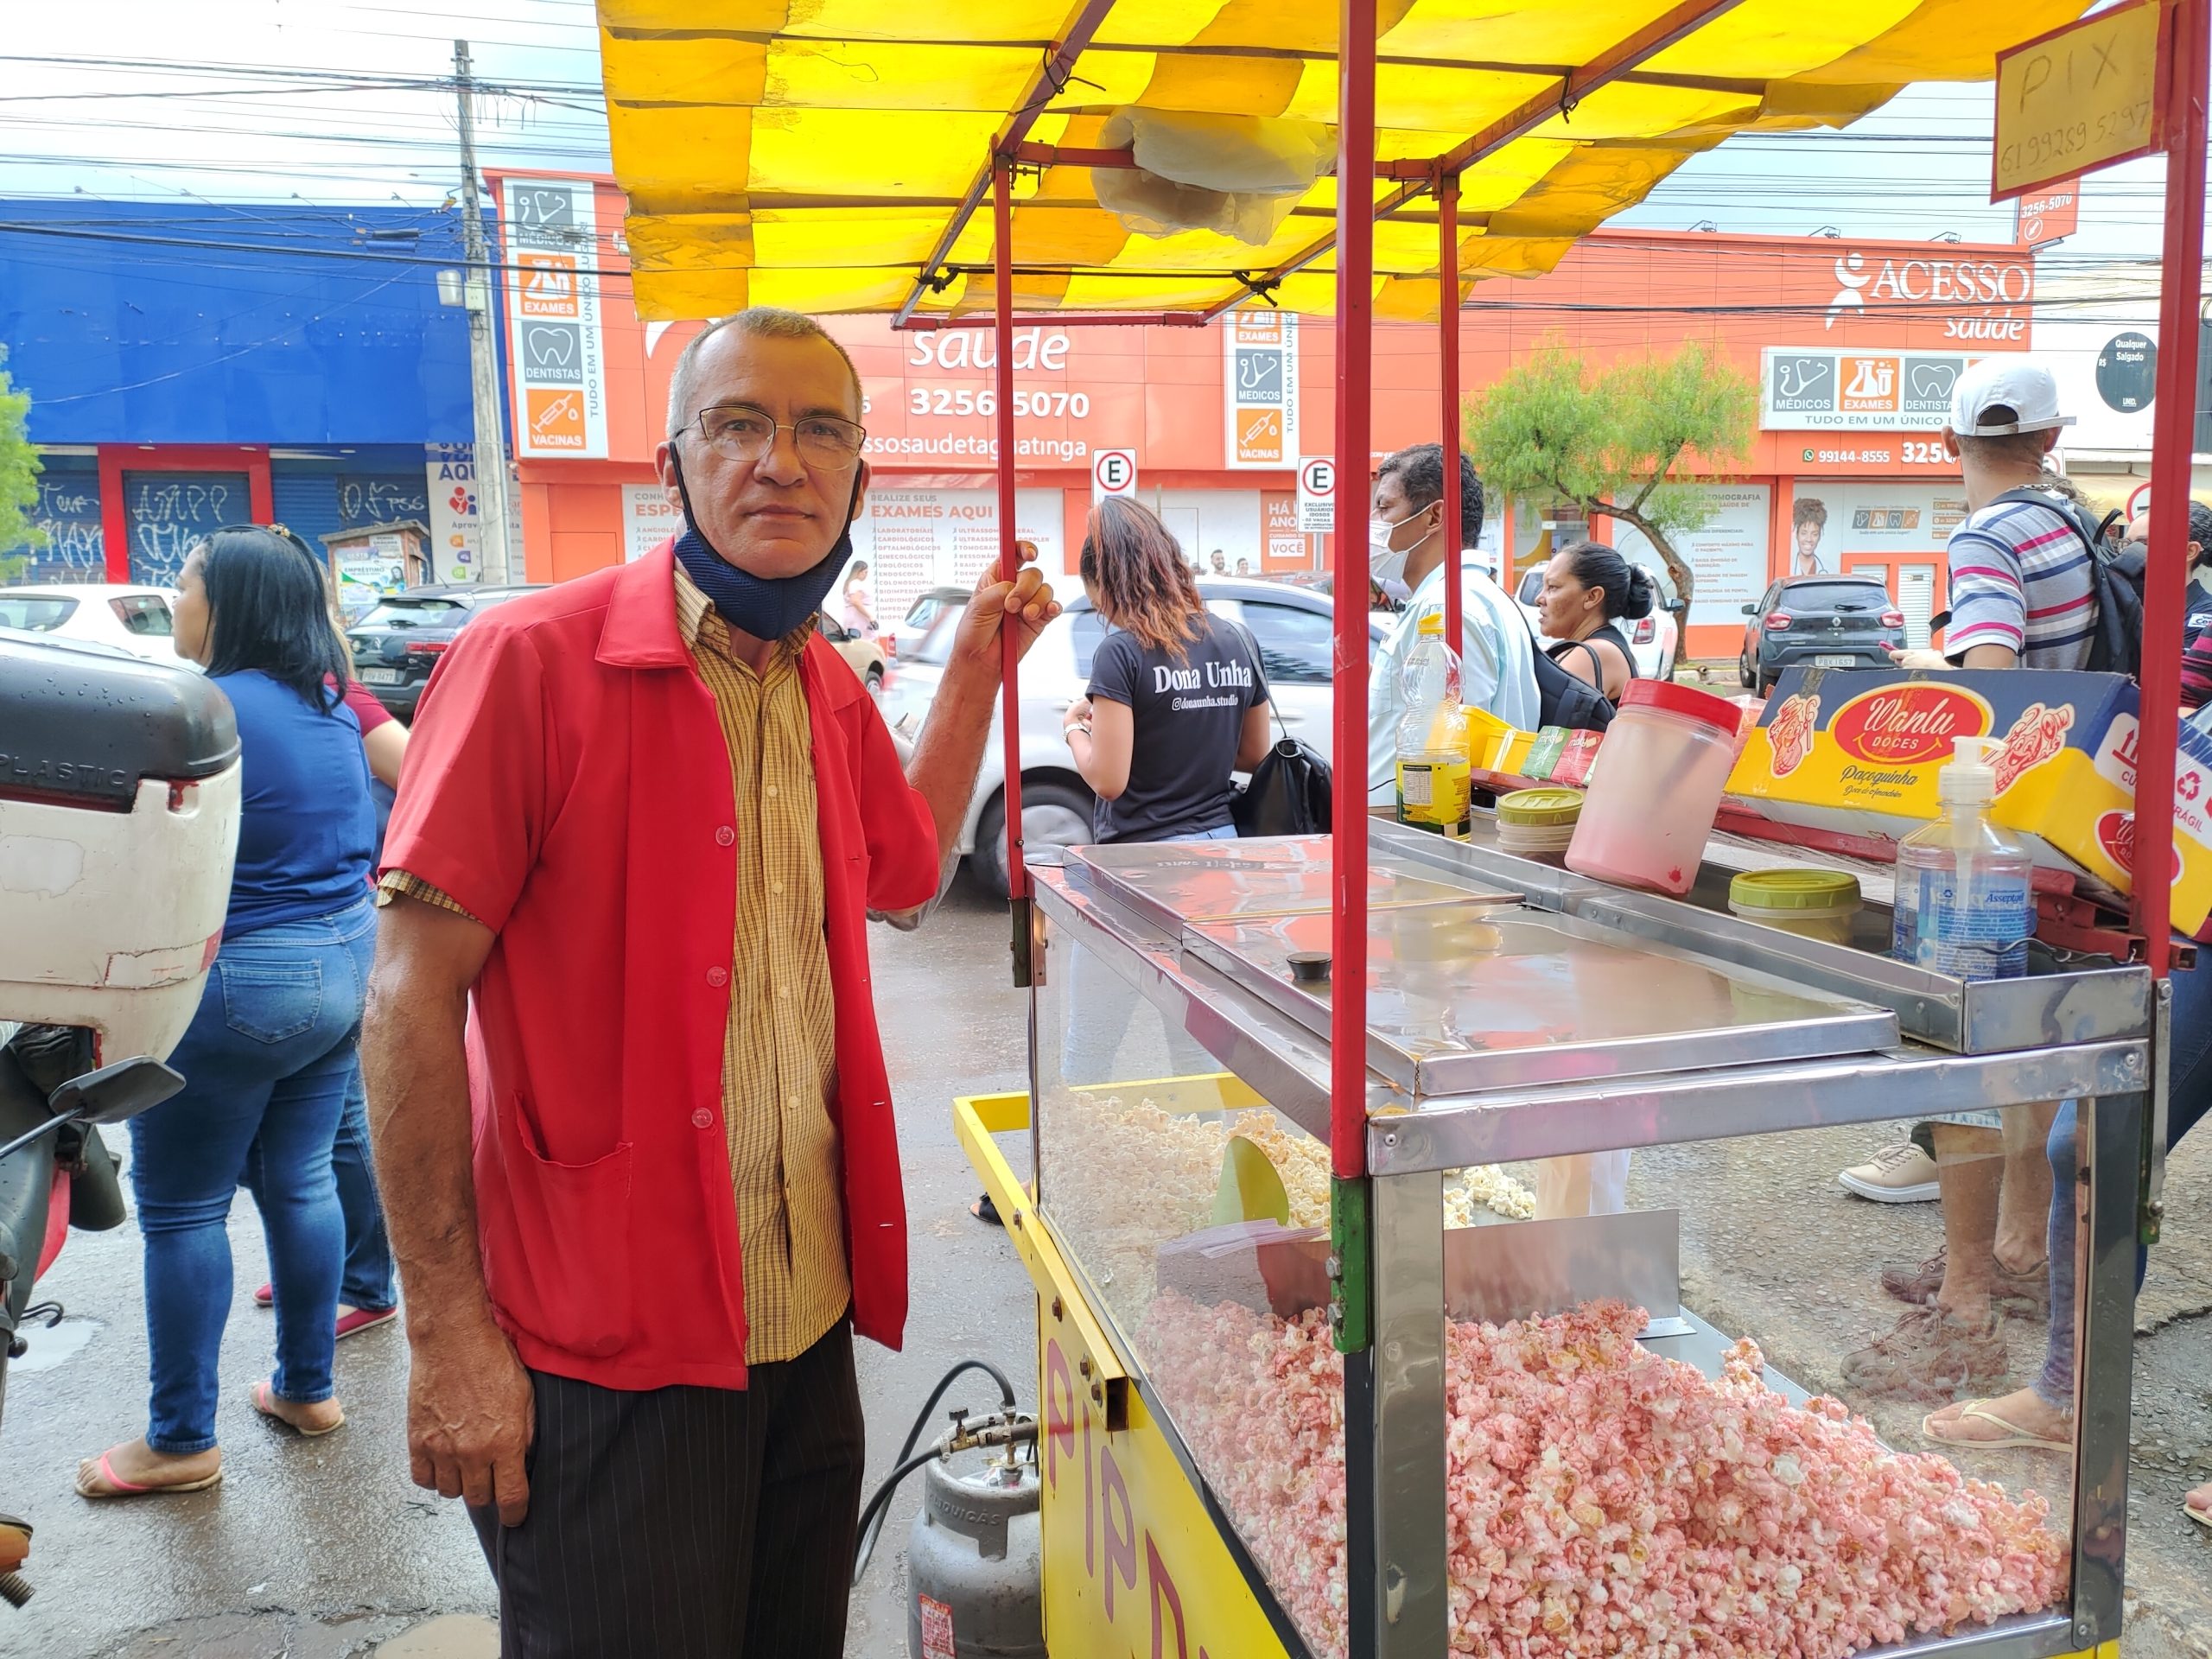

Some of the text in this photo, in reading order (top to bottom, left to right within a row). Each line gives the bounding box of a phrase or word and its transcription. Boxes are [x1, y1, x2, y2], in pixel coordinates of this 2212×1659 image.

[2019, 33, 2120, 113] PIX
[2022, 192, 2073, 219] 3256-5070
[519, 232, 571, 246] MÉDICO
[1869, 258, 2031, 302] ACESSO
[582, 276, 594, 322] ÚNICO
[524, 301, 575, 315] EXAMES
[1942, 309, 2025, 340] saúde
[585, 327, 594, 350] UM
[1238, 331, 1279, 342] EXAMES
[2115, 339, 2147, 350] Qualquer
[587, 354, 597, 374] EM
[1287, 353, 1293, 372] UM
[2098, 358, 2107, 367] R$
[2116, 352, 2145, 363] Salgado
[525, 367, 582, 380] DENTISTAS
[1287, 377, 1294, 394] EM
[588, 378, 599, 418] TUDO
[1776, 397, 1831, 410] MÉDICOS
[1844, 400, 1893, 410] EXAMES
[1905, 400, 1952, 410] DENTISTA
[1804, 412, 1943, 426] TUDO EM UM ÚNICO
[531, 434, 583, 446] VACINAS
[1240, 448, 1280, 459] VACINAS
[1818, 450, 1891, 463] 99144-8555
[1108, 460, 1121, 482] E
[1313, 467, 1328, 488] E
[871, 505, 993, 520] EXAMES AQUI
[1268, 499, 1290, 515] HÁ
[1269, 517, 1297, 528] ANO
[1272, 541, 1304, 553] VOCÊ
[1153, 658, 1253, 694] Dona Unha
[1863, 696, 1957, 735] Wanlu
[1872, 738, 1919, 749] DOCES
[1840, 765, 1919, 787] Paçoquinha
[2172, 804, 2203, 834] RÁGIL
[1985, 892, 2025, 905] Asseptgel
